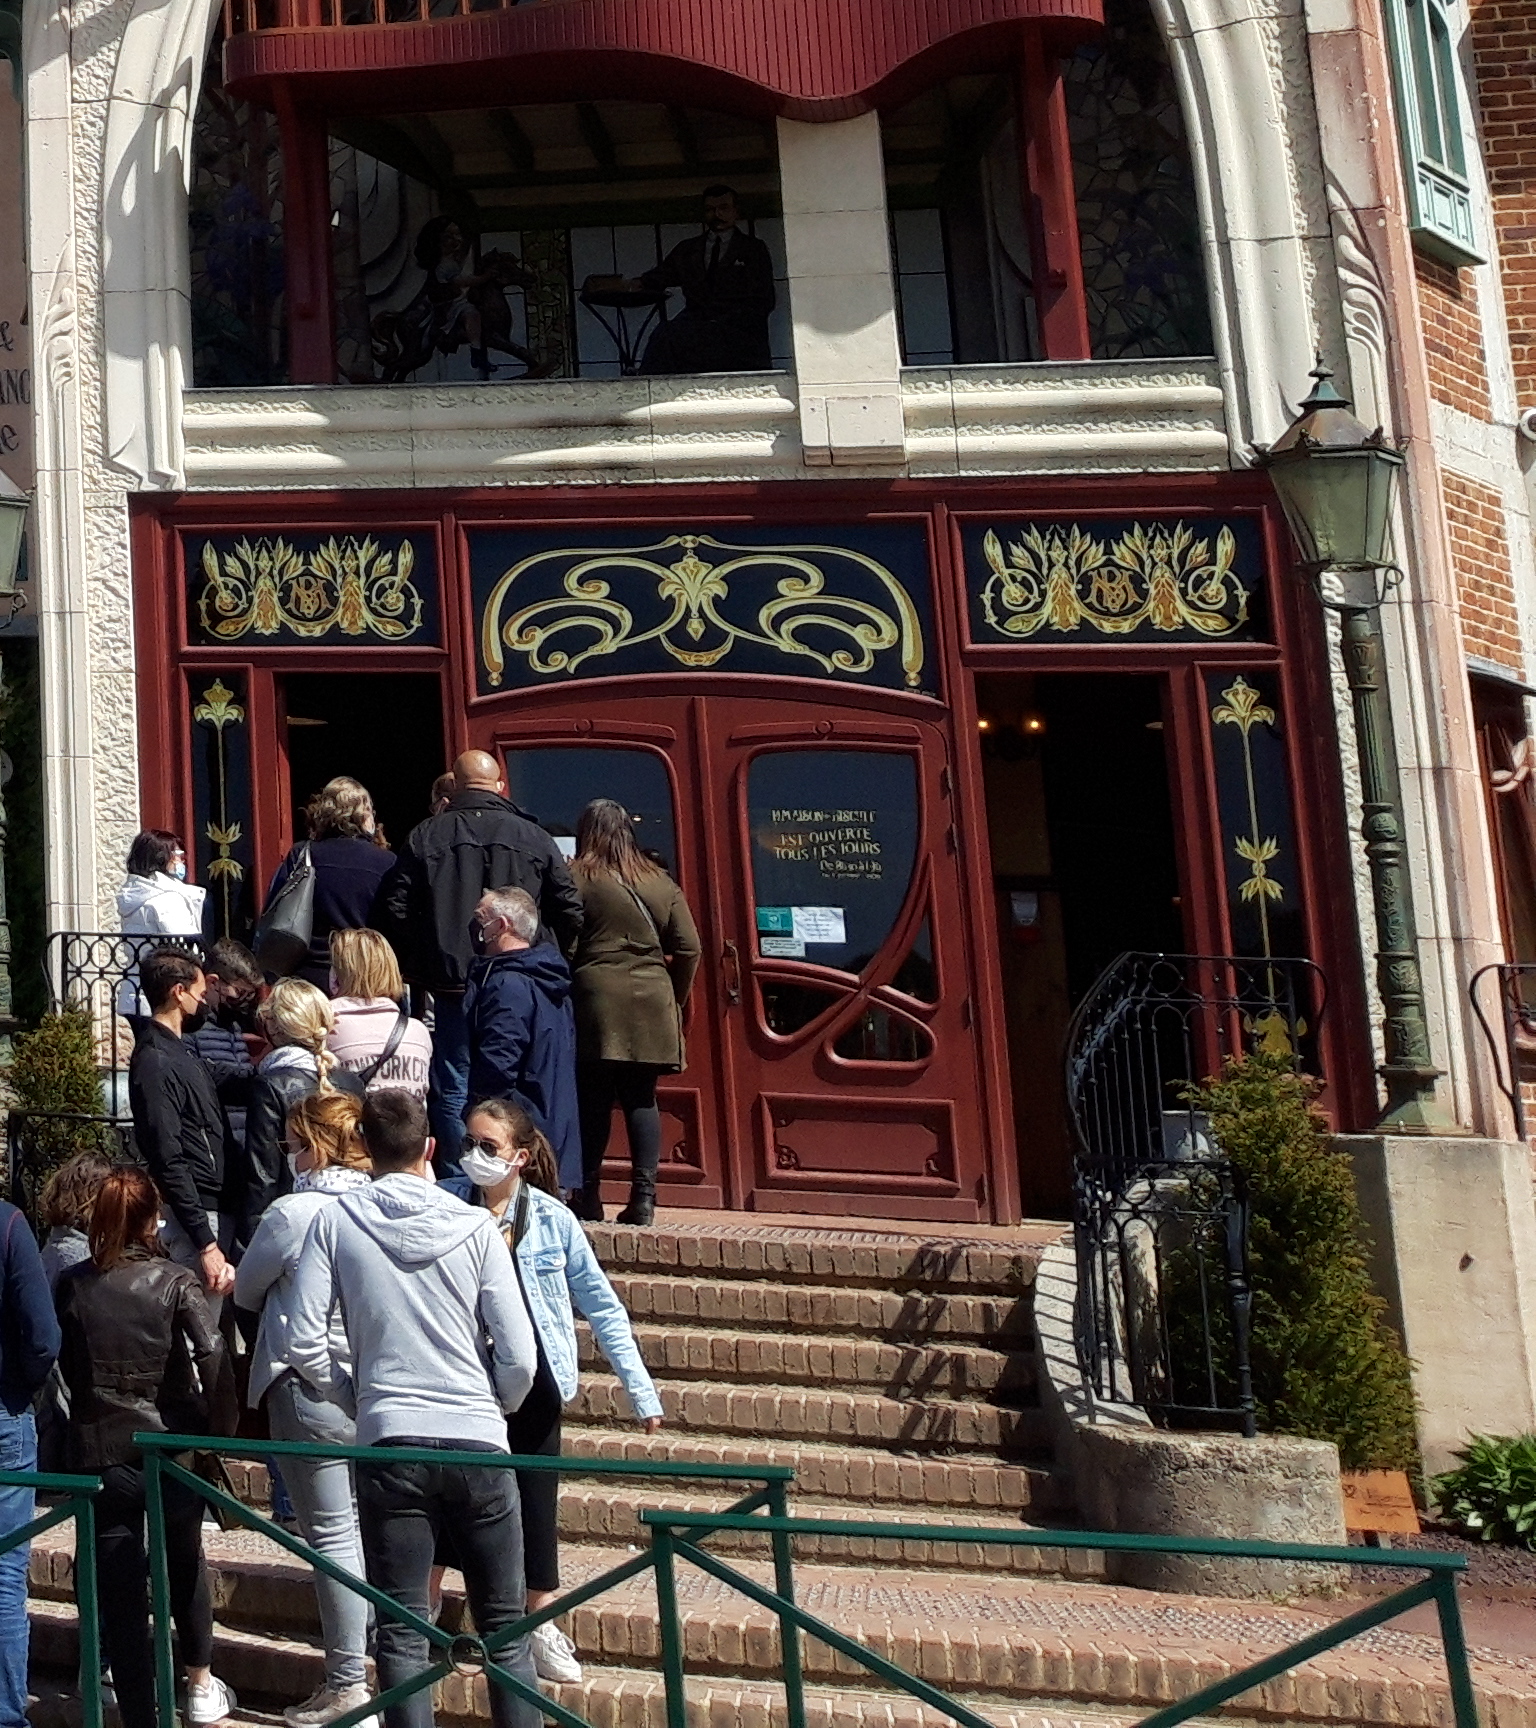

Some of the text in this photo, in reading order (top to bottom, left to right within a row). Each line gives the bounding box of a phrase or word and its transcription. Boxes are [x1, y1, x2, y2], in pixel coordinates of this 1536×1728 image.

[780, 827, 872, 847] EST OUVERTE
[774, 846, 809, 861] TOUS
